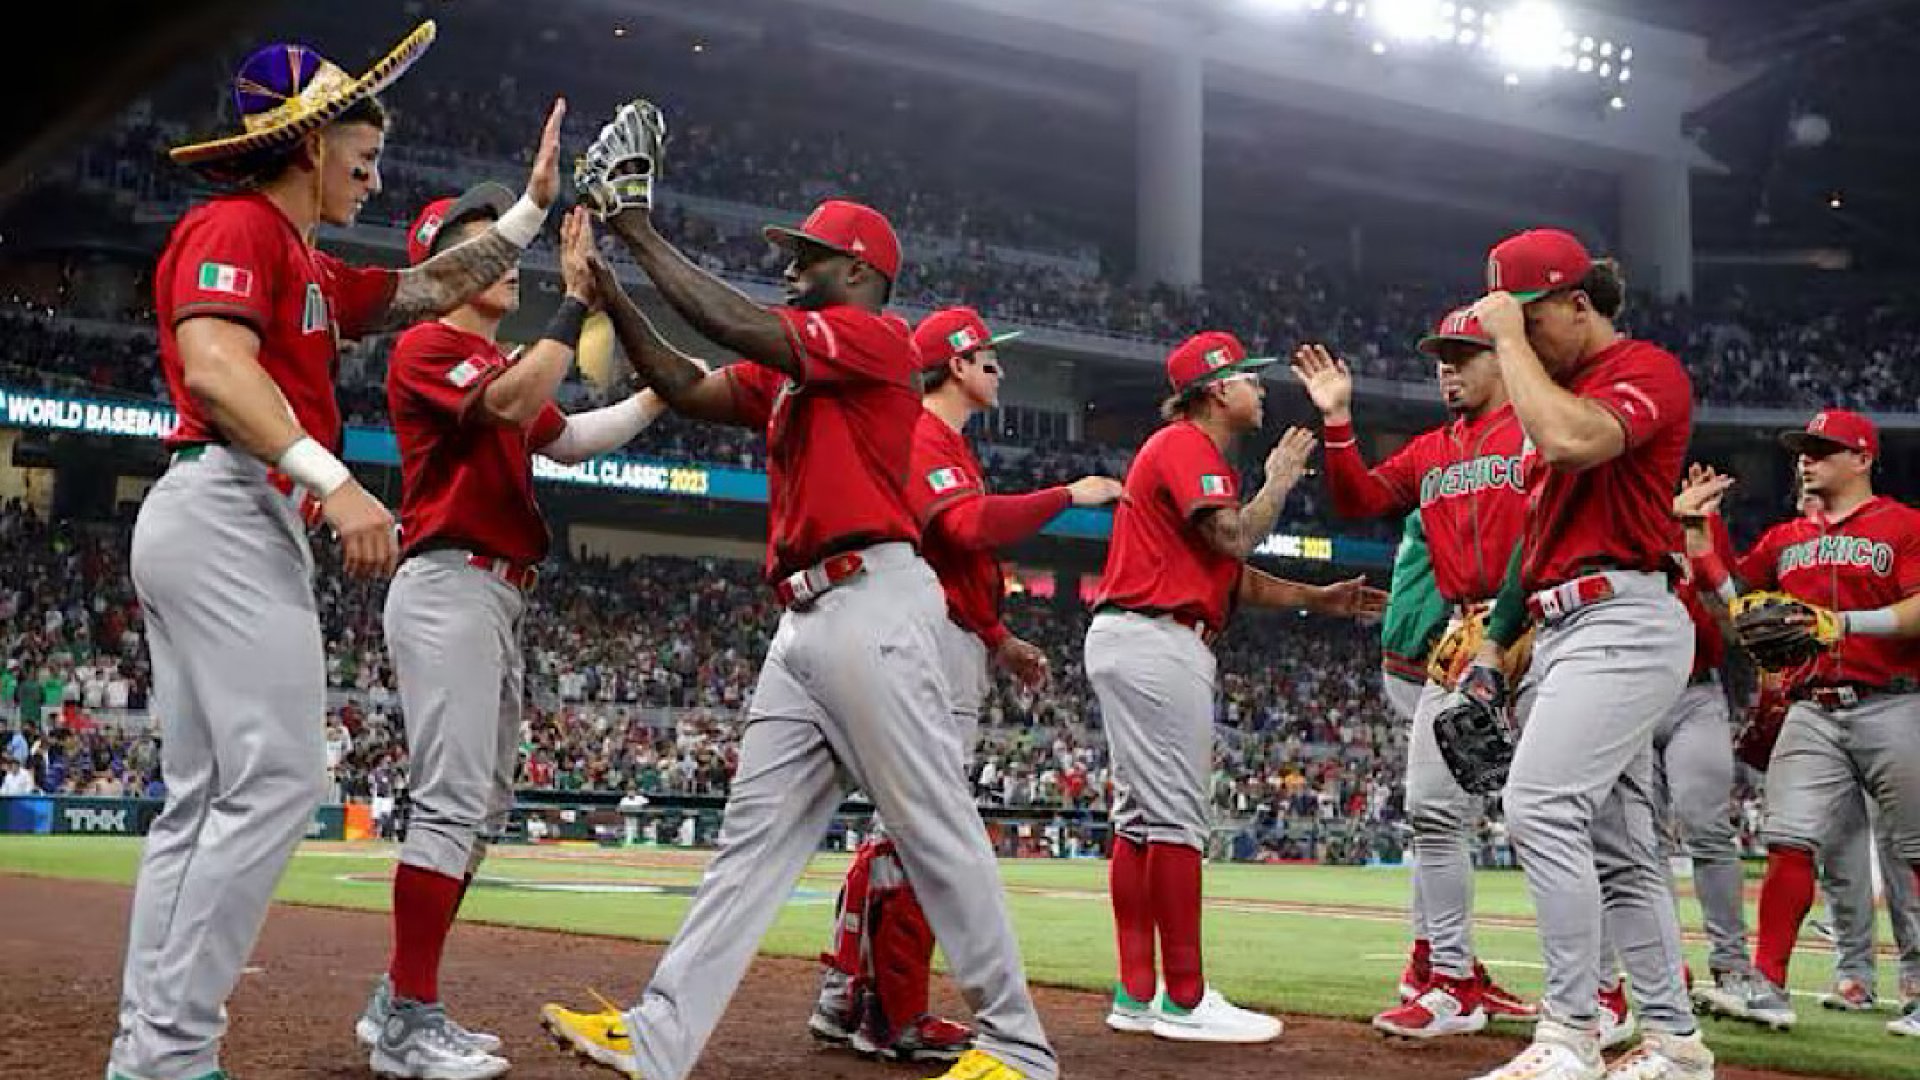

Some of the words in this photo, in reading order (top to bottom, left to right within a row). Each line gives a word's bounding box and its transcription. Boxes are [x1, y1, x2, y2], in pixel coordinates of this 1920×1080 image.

[9, 394, 82, 428] WORLD
[601, 460, 670, 489] CLASSIC
[1777, 535, 1895, 578] MEXICO
